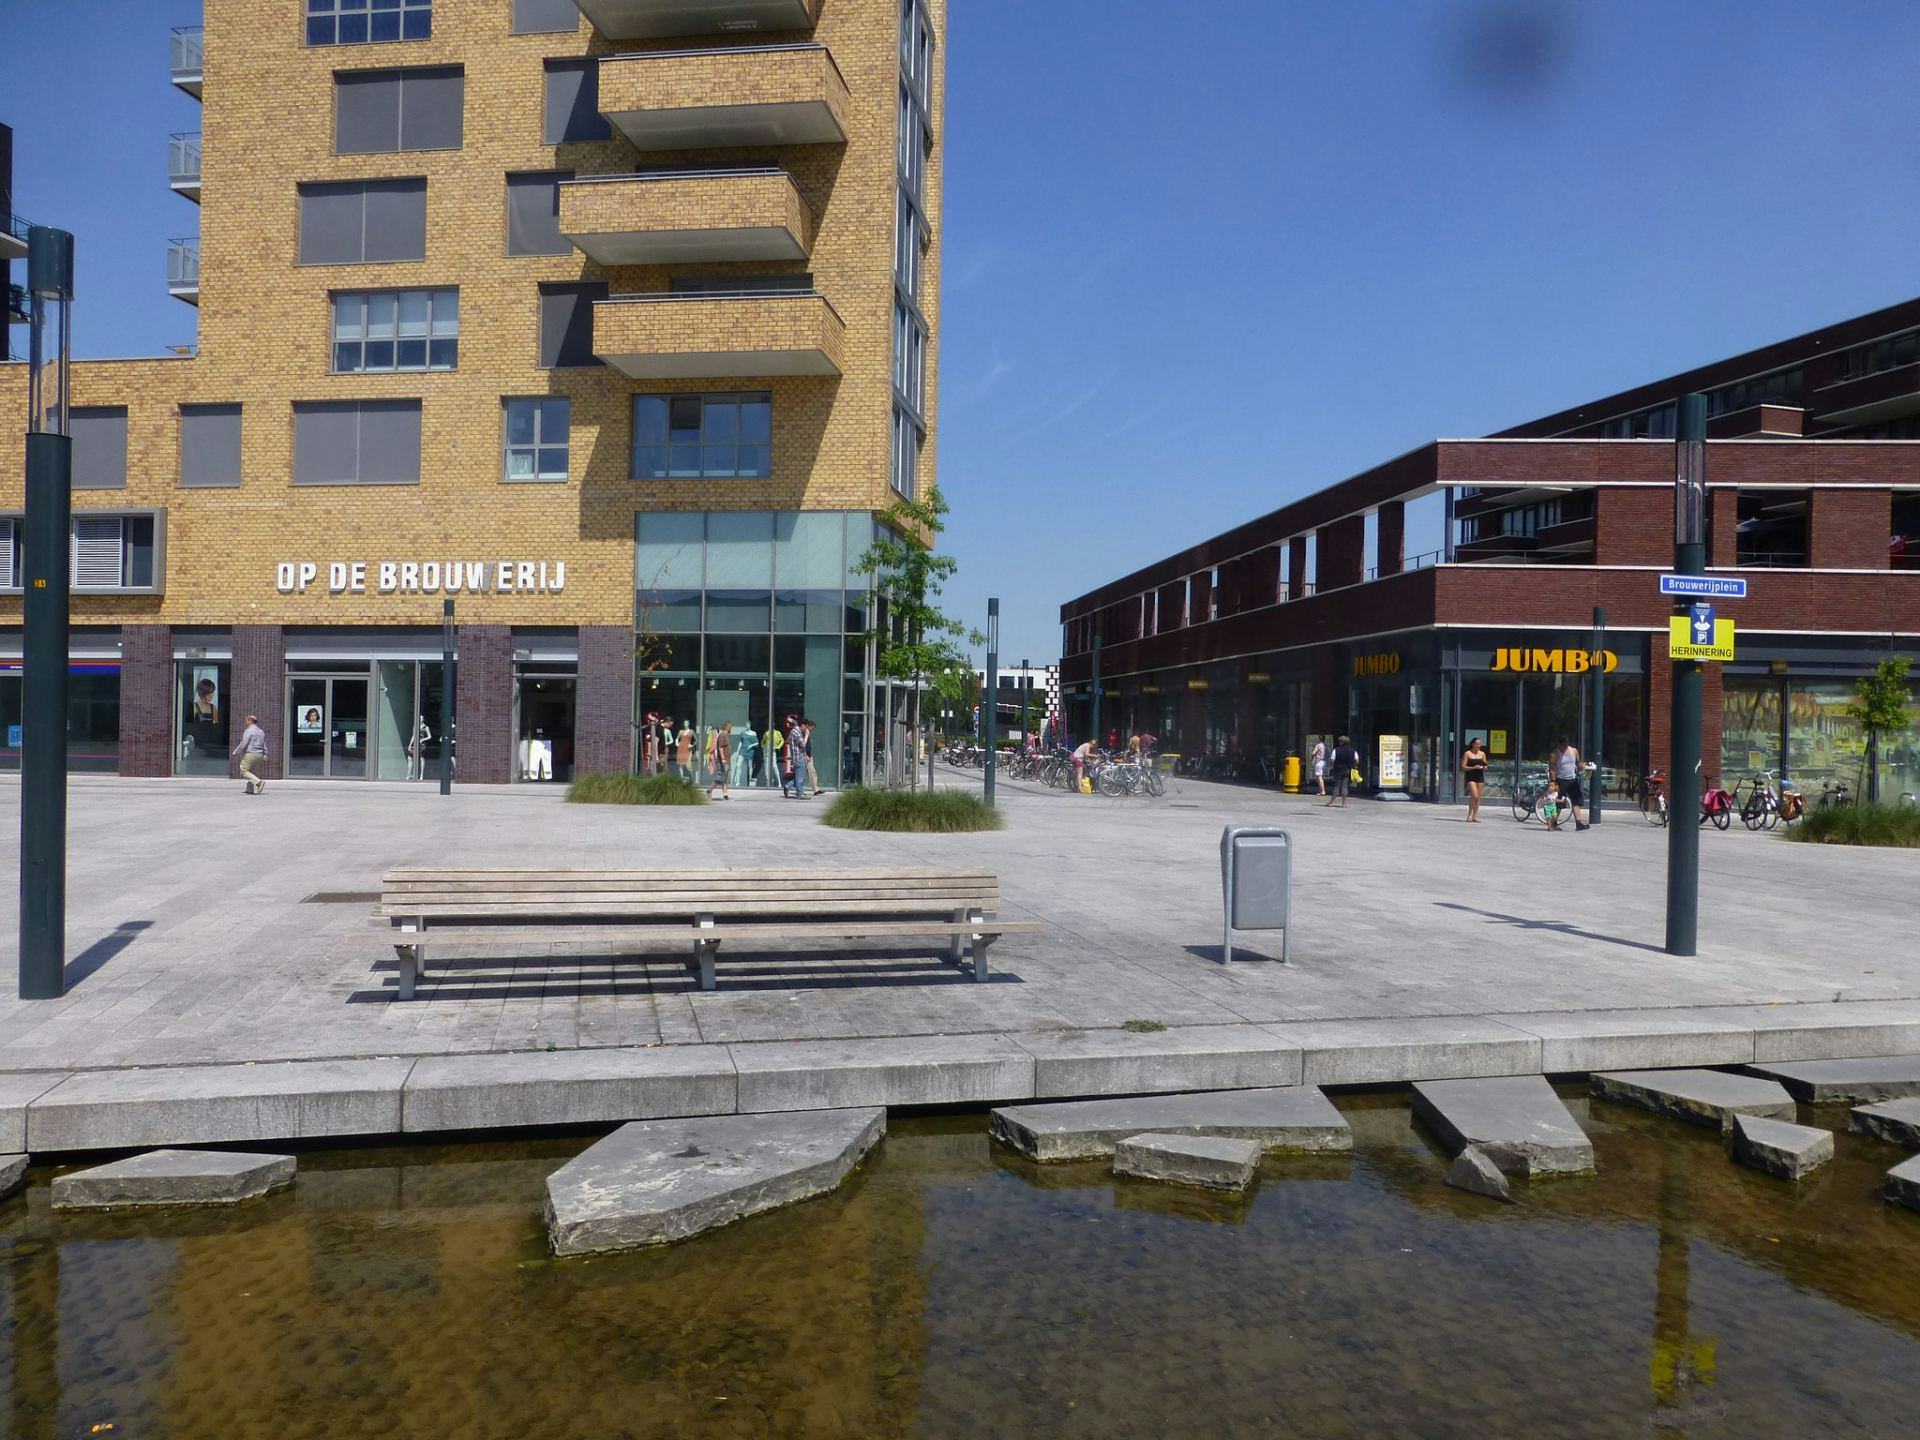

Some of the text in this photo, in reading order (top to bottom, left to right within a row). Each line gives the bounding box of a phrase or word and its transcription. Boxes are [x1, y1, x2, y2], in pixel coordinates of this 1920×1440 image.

[277, 562, 566, 591] OP DE BROUWERIJ
[1669, 579, 1738, 592] Brouwerijplein
[1491, 648, 1618, 673] JUMBO
[1671, 646, 1732, 657] HERINNERING
[1353, 652, 1400, 677] JUMBO
